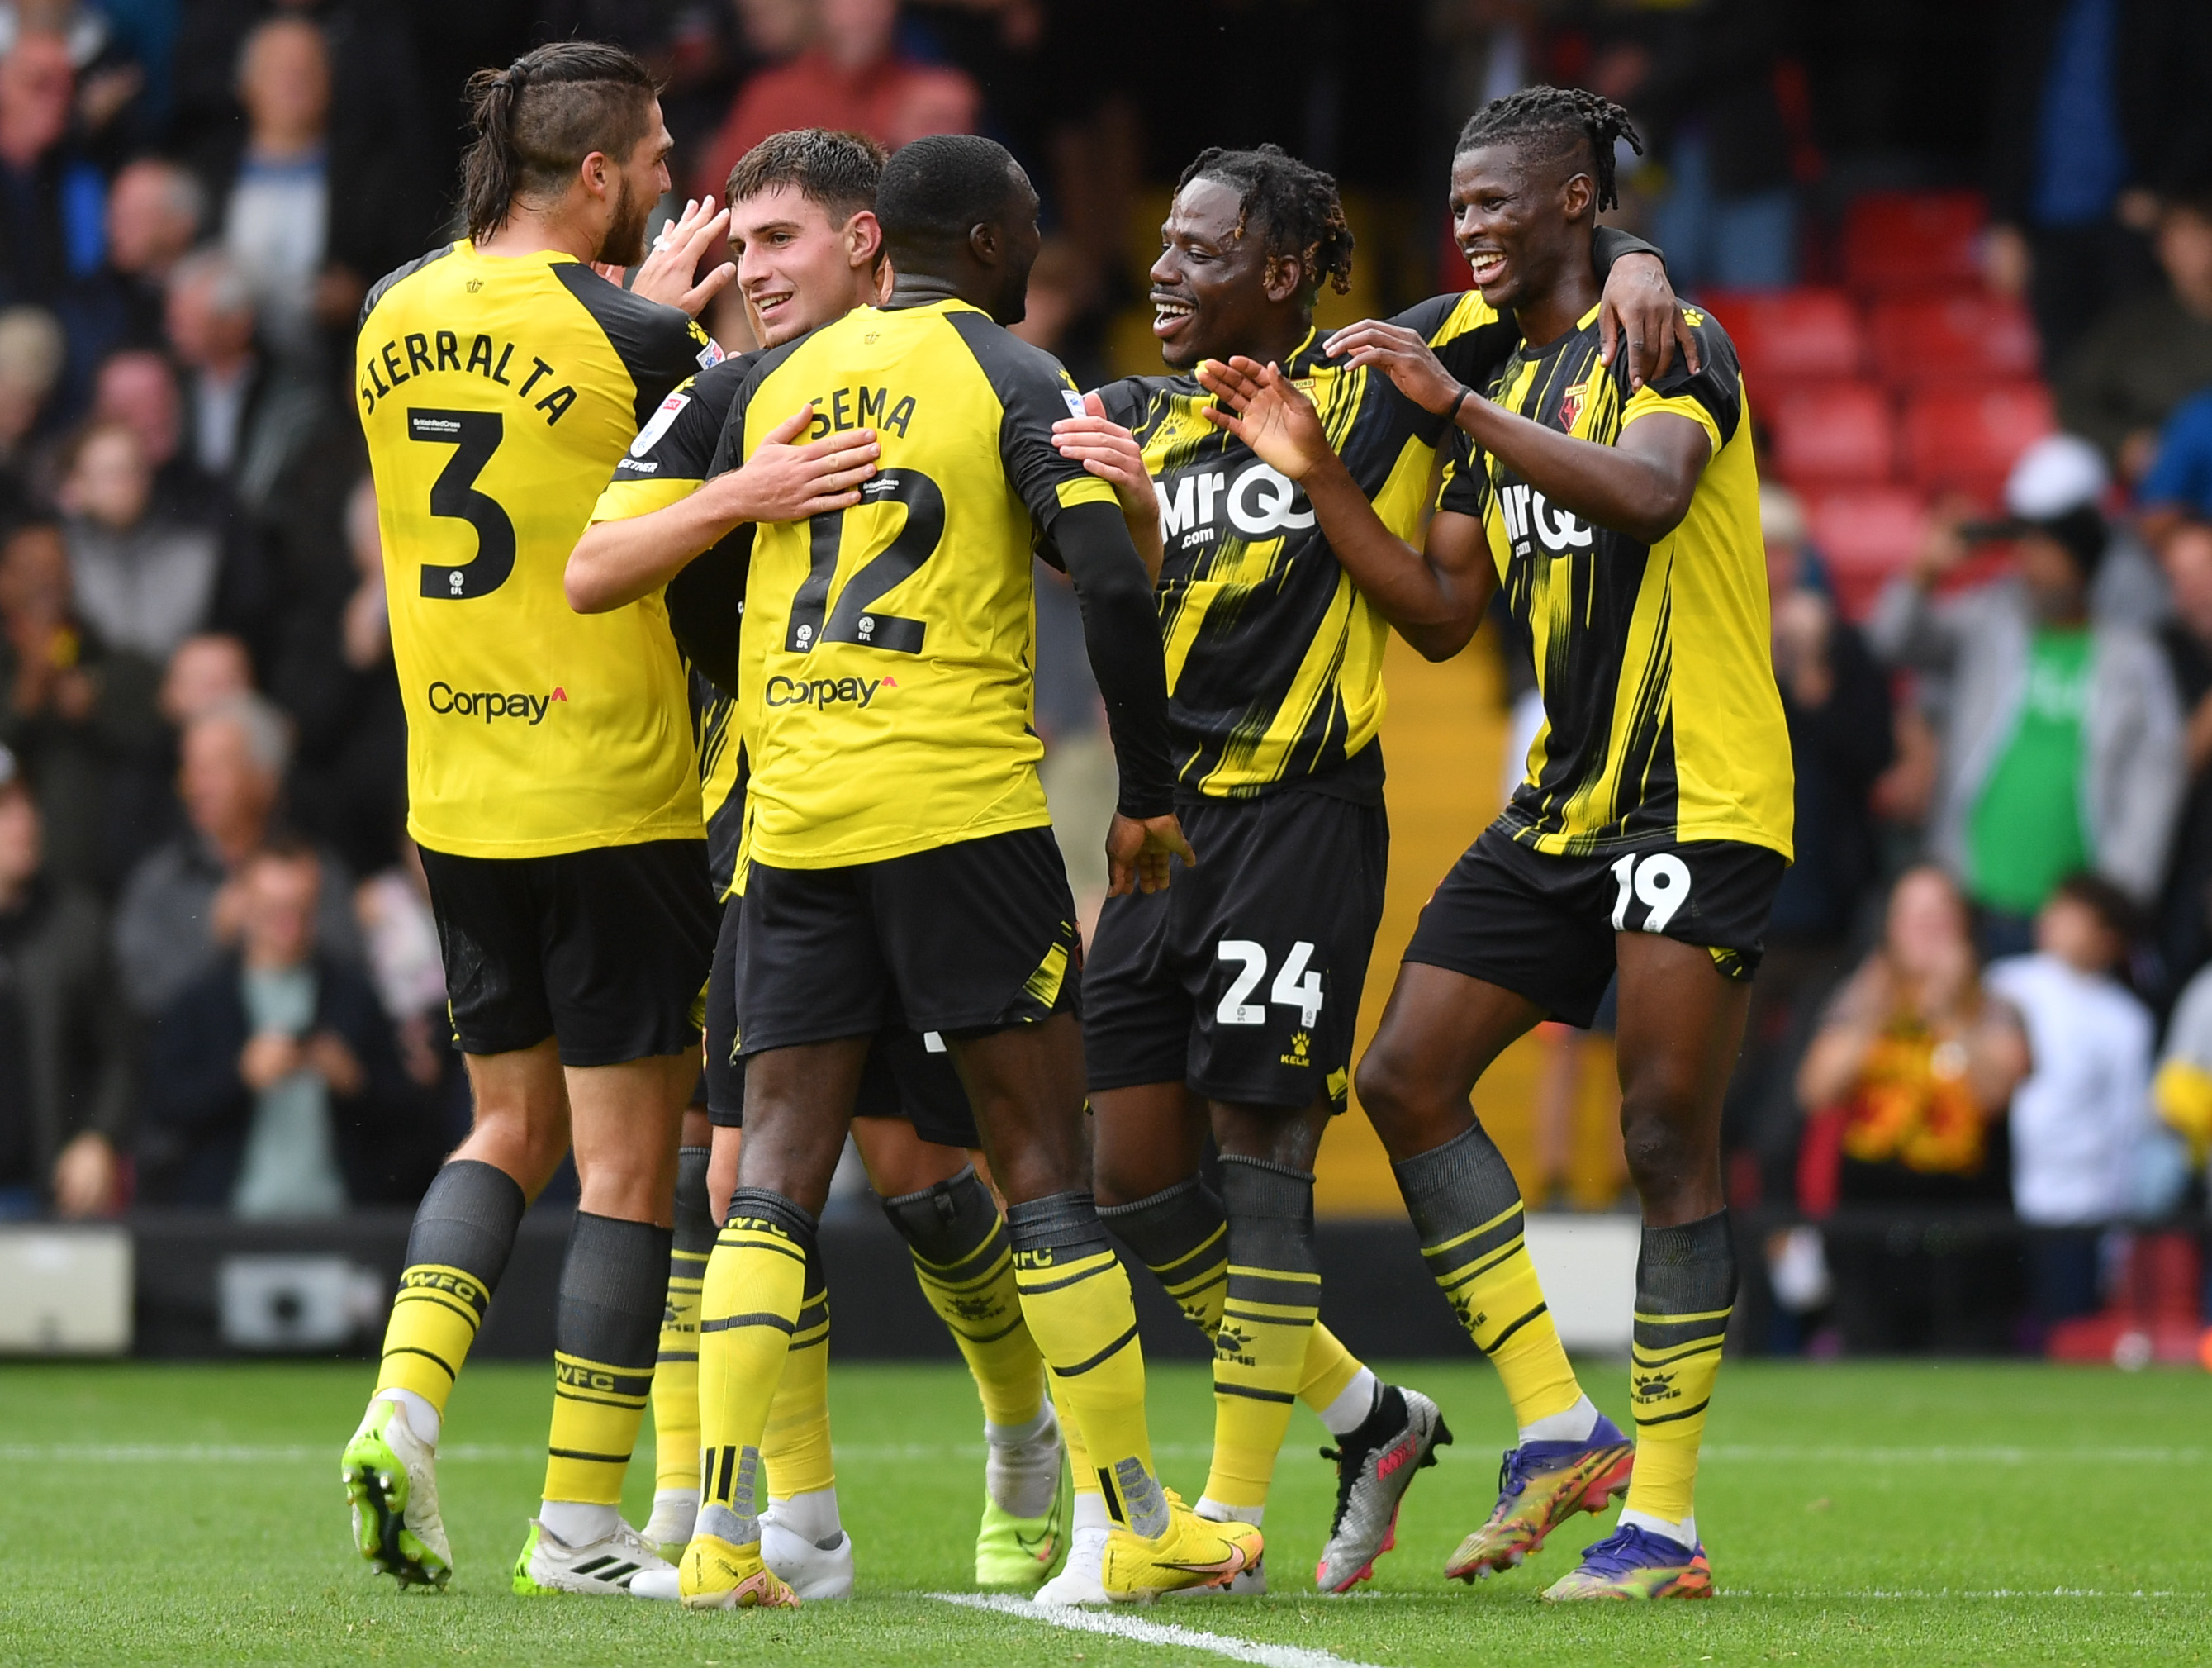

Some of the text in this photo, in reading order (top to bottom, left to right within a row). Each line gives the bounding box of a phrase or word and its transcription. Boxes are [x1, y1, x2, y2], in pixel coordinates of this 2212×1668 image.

[360, 330, 577, 427] SIERRALTA
[809, 386, 916, 439] SEMA
[407, 406, 516, 600] 3
[785, 468, 946, 654] 12
[450, 587, 463, 595] EFL
[796, 639, 809, 649] EFL
[858, 632, 871, 641] EFL
[429, 681, 550, 725] Corpay
[766, 676, 880, 711] Corpay
[1610, 853, 1691, 933] 19
[1217, 940, 1323, 1029] 24
[406, 1272, 476, 1302] WFC
[555, 1361, 614, 1390] WFC
